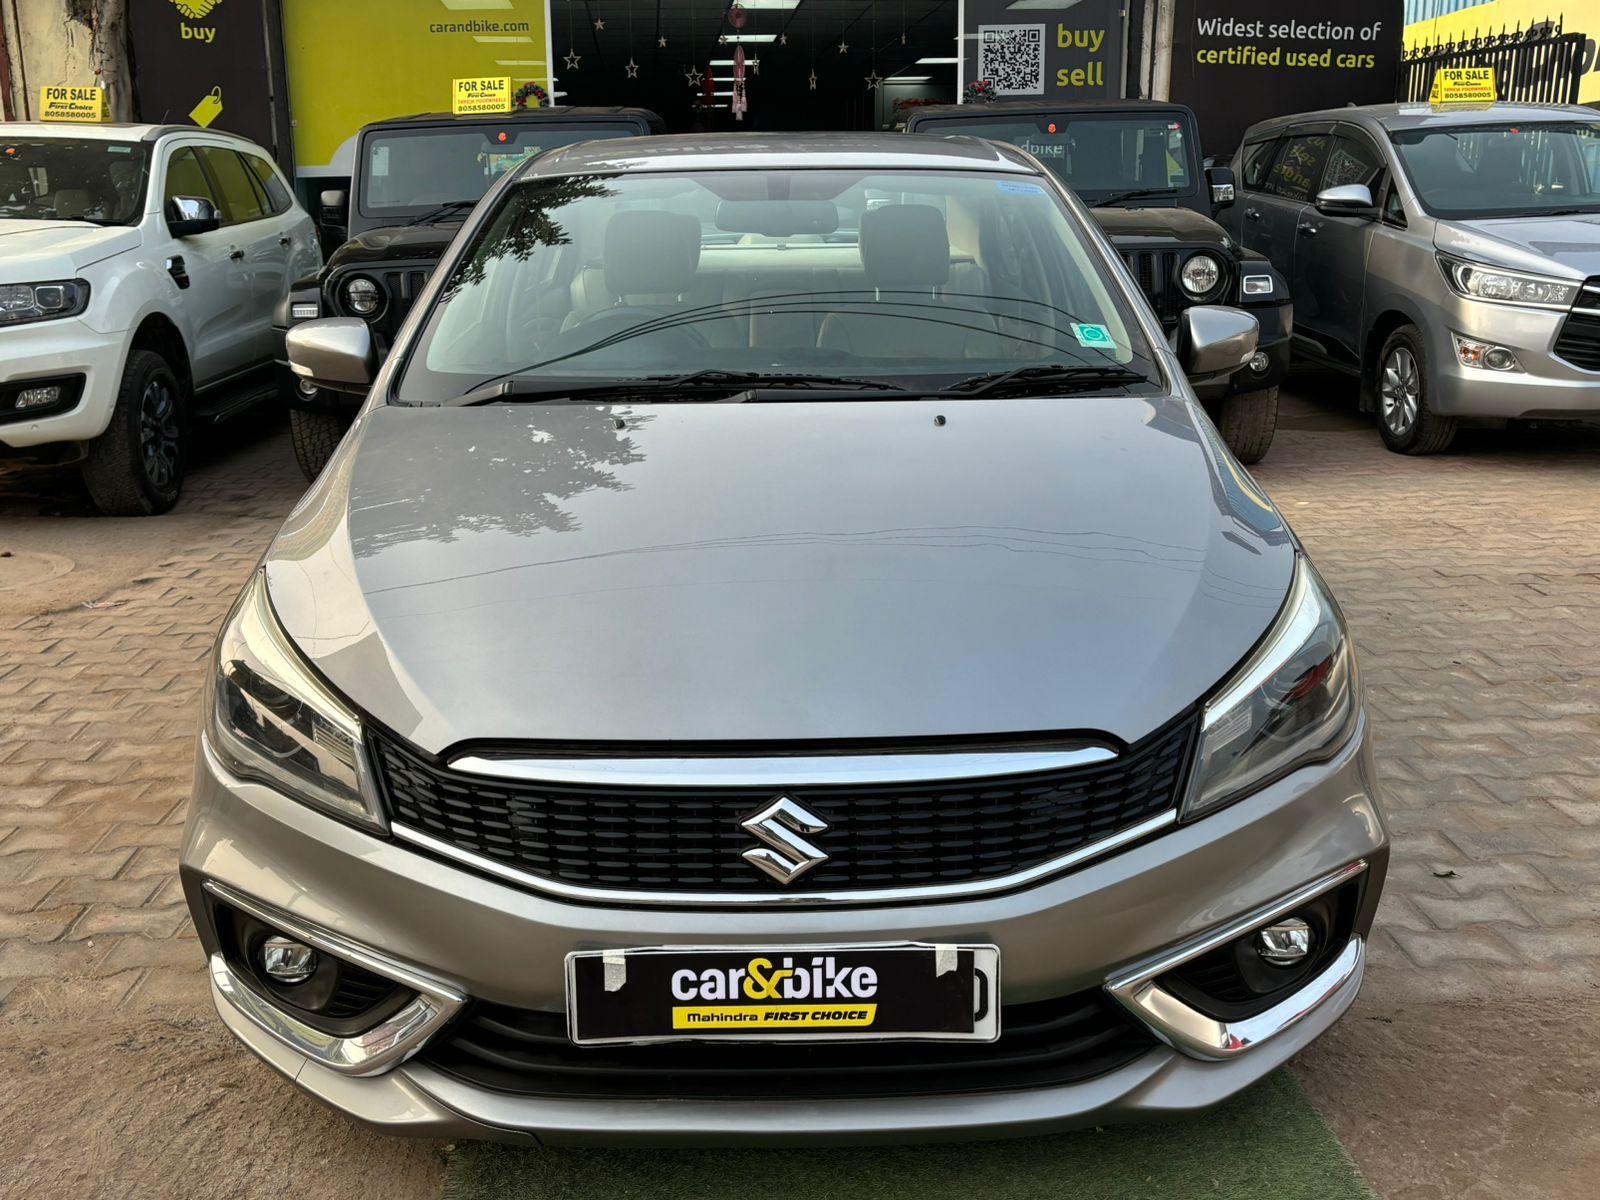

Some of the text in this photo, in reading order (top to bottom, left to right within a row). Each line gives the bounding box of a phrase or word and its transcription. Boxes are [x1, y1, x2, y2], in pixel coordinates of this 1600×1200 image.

[180, 22, 216, 43] buy
[429, 20, 529, 33] carandbike.com
[1196, 17, 1382, 41] Widest selection of
[1056, 23, 1105, 53] buy
[1196, 45, 1375, 69] certified used cars
[1056, 61, 1104, 87] sell
[1444, 70, 1489, 80] FOR SALE
[46, 88, 96, 100] FOR SALE
[458, 80, 504, 92] FOR SALE
[458, 104, 506, 112] 8058580005
[671, 957, 878, 1000] car&bike
[687, 1010, 868, 1022] Mahindra FIRST CHOICE
